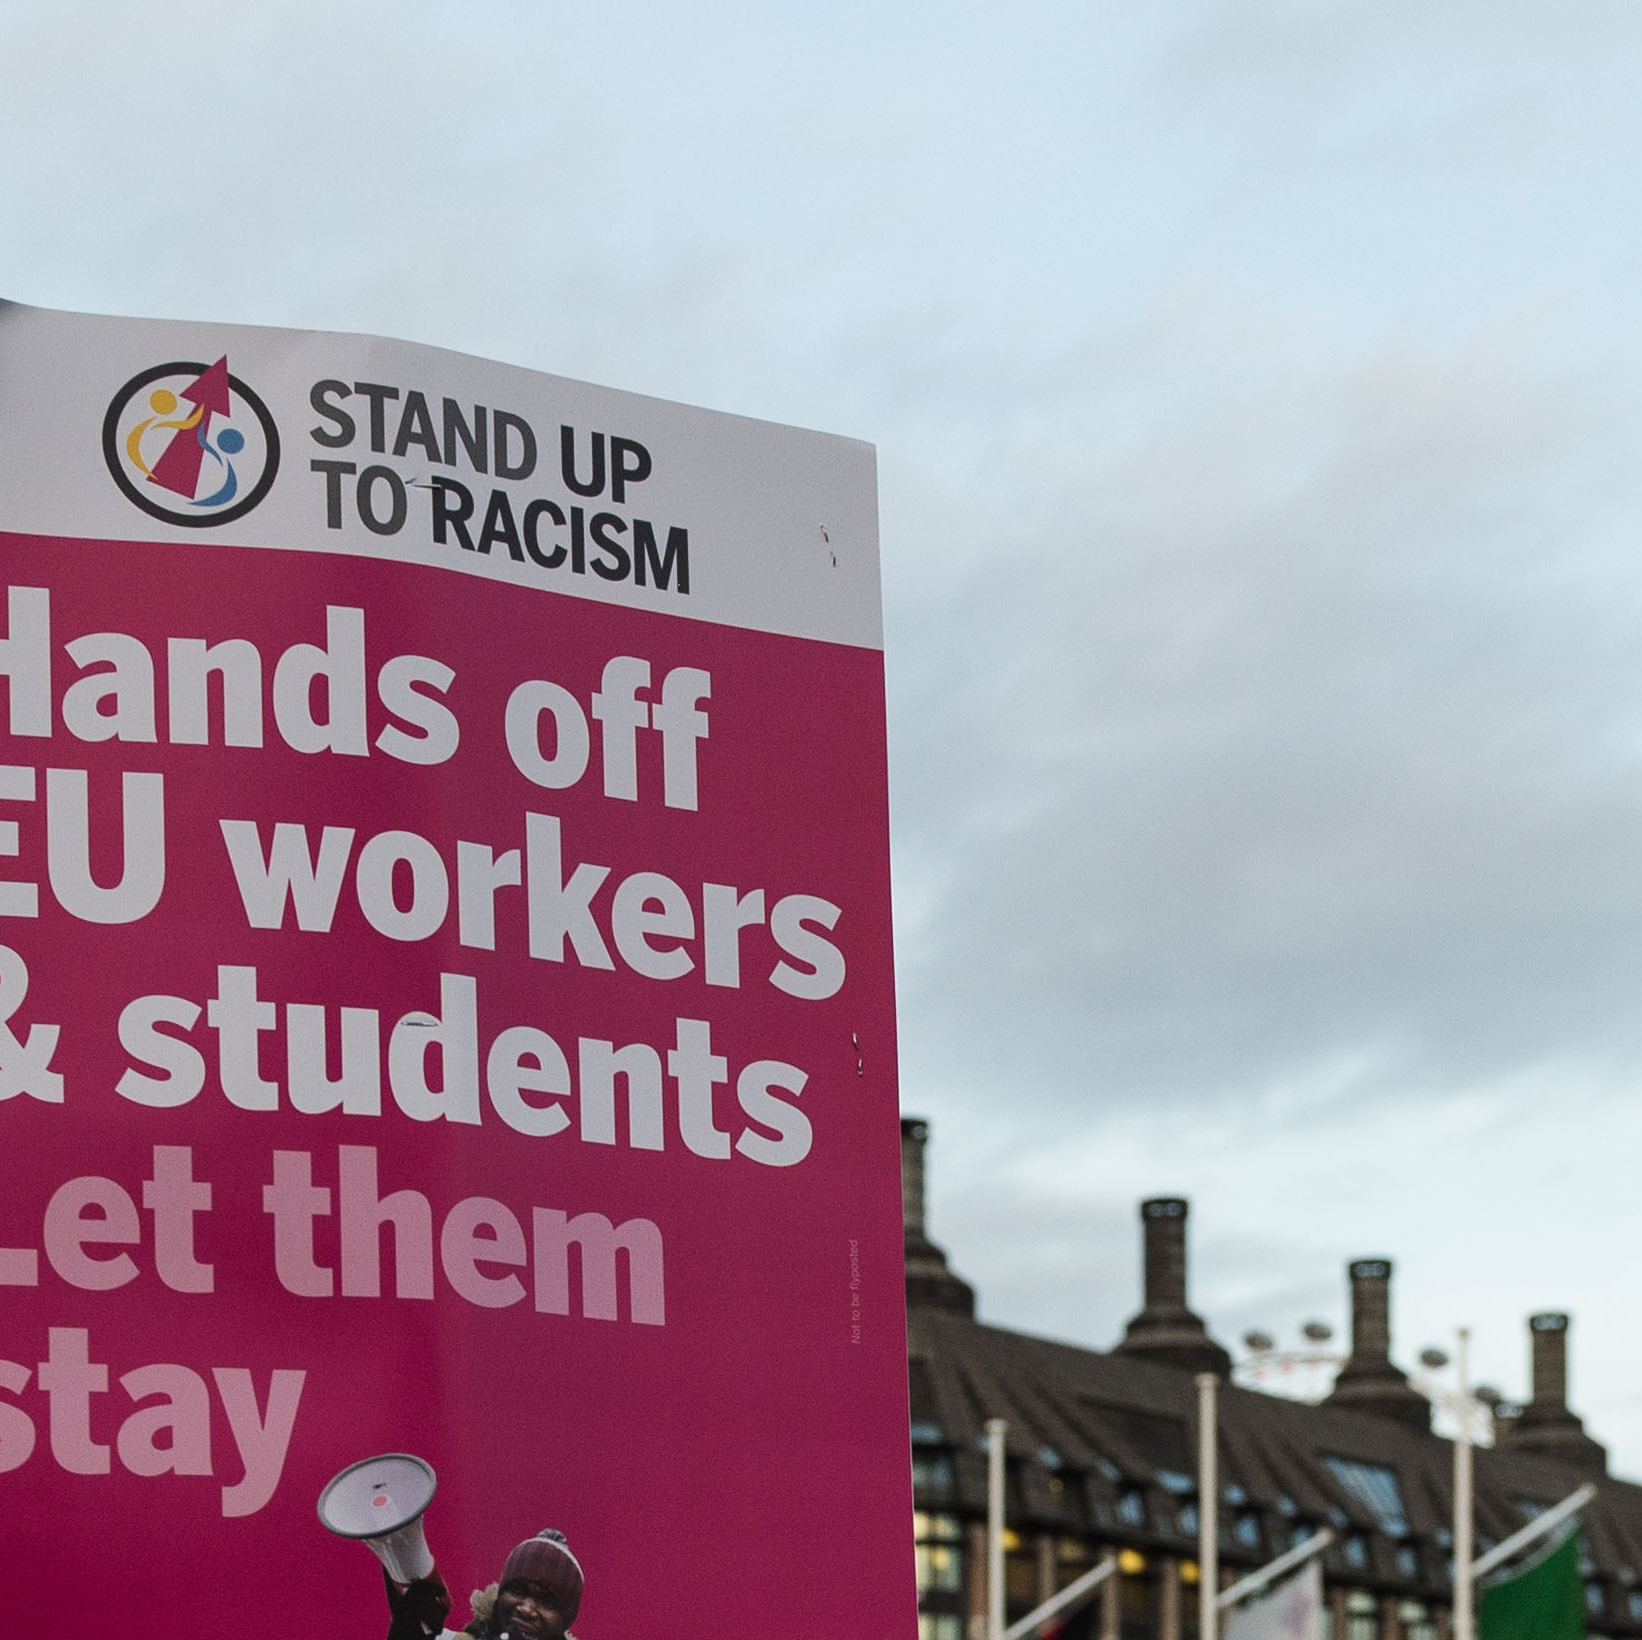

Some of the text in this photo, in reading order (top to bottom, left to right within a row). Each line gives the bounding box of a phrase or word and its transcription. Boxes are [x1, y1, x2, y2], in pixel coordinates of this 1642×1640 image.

[310, 380, 651, 504] STAND UP
[311, 460, 689, 595] TO RACISM
[505, 656, 711, 811] off
[219, 812, 845, 999] workers
[115, 966, 814, 1167] students
[263, 1145, 665, 1325] them
